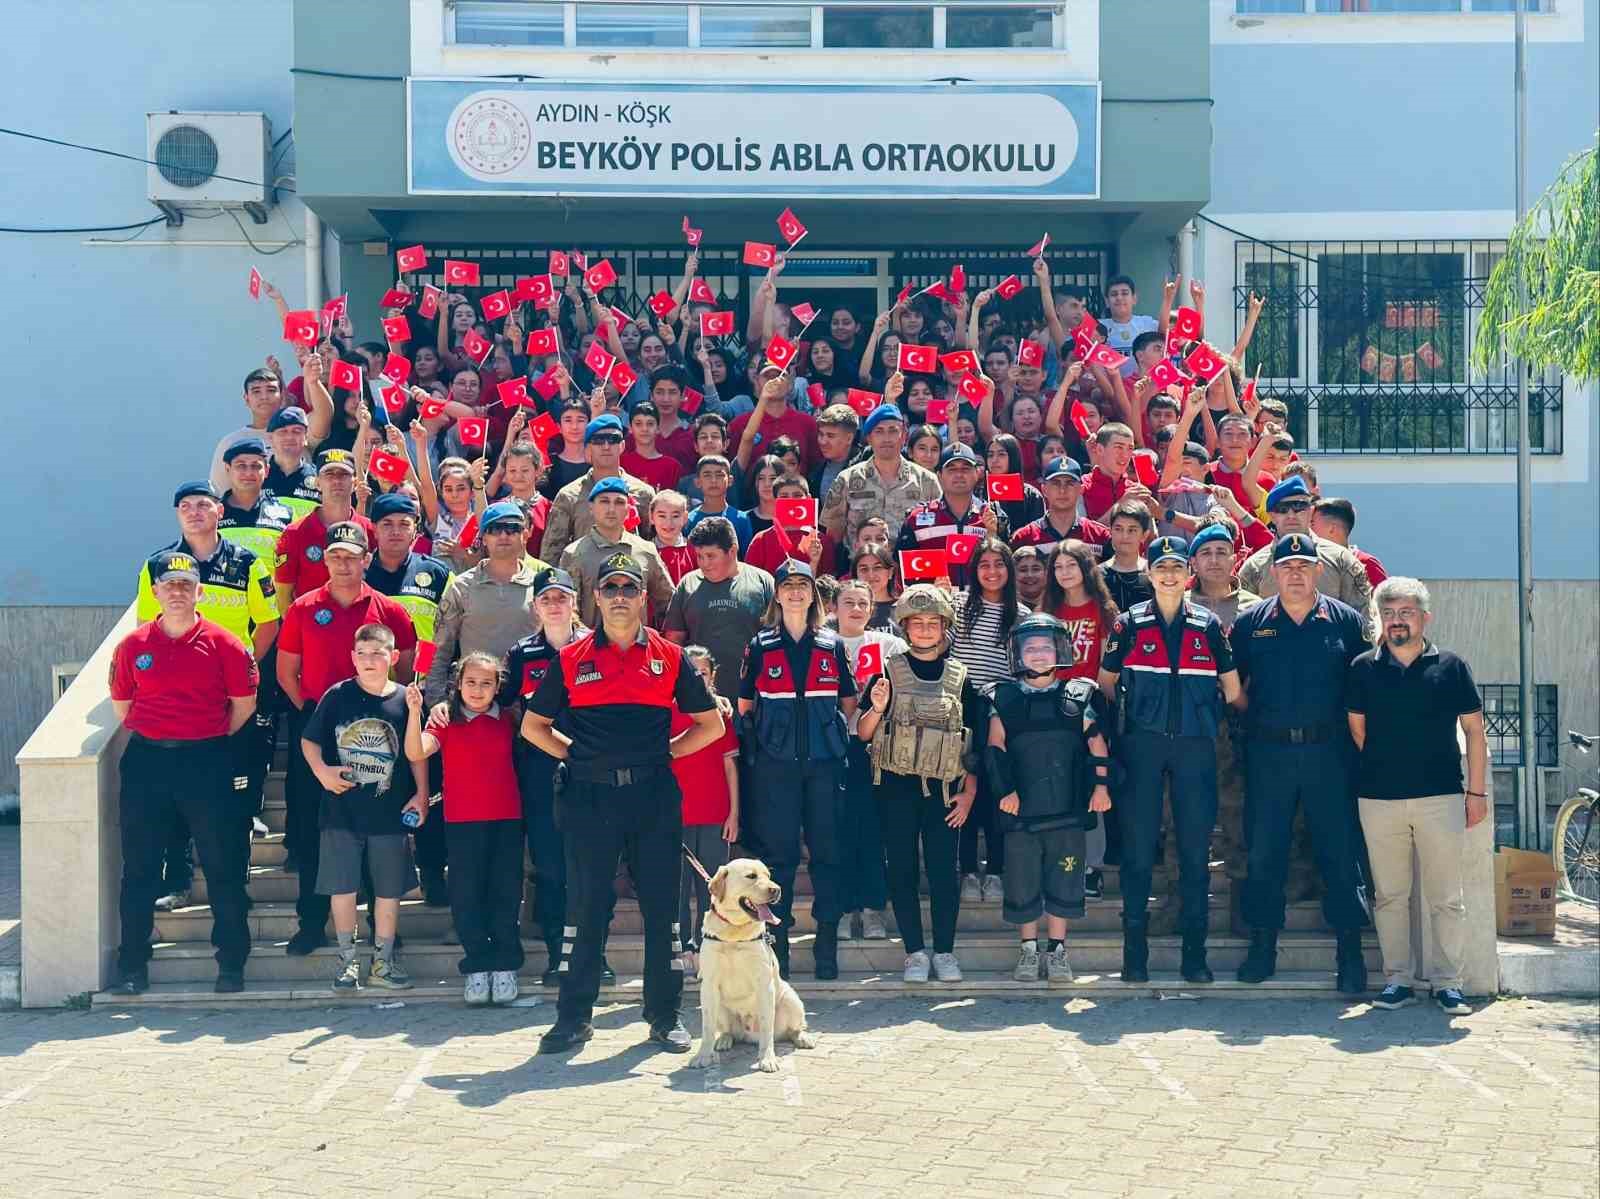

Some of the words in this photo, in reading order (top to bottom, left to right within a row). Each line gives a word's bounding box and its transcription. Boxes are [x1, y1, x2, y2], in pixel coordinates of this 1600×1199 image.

[536, 103, 598, 123] AYDIN
[617, 101, 672, 129] KÖŞK
[537, 135, 662, 171] BEYKÖY
[671, 136, 762, 172] POLİS
[769, 143, 854, 171] ABLA
[862, 143, 1056, 172] ORTAOKULU
[334, 527, 356, 540] JAK
[167, 556, 193, 571] JAK
